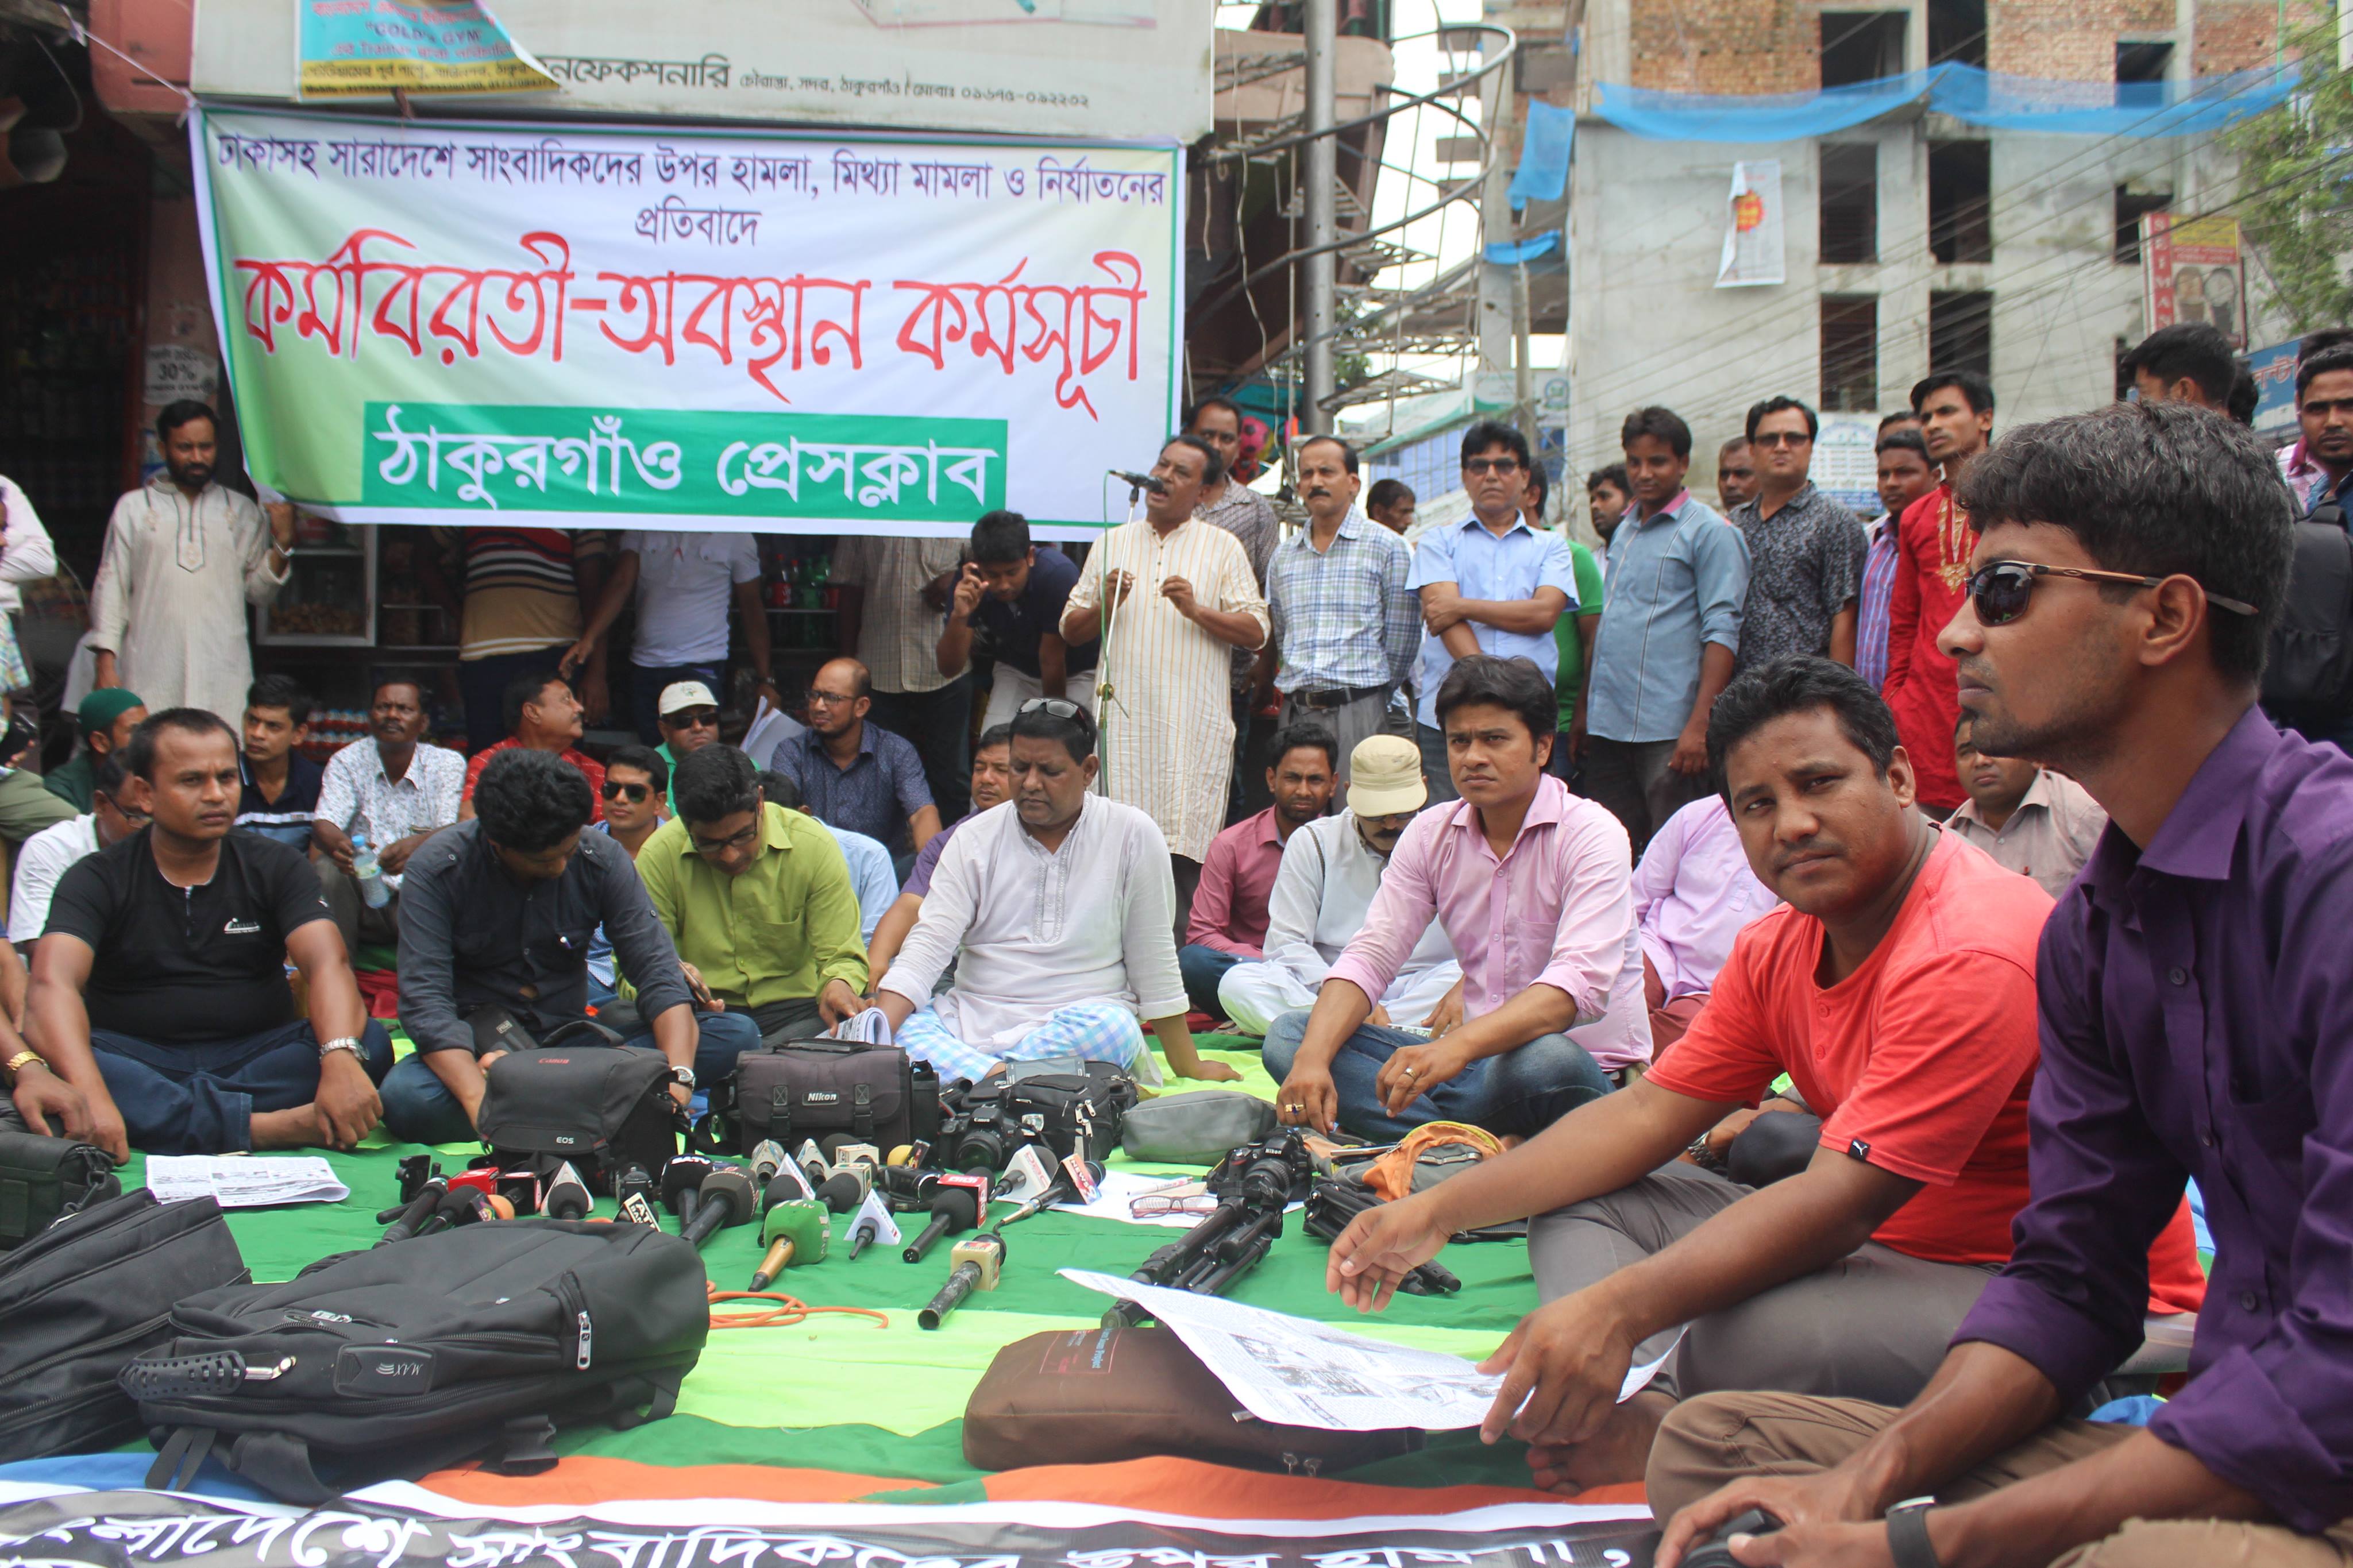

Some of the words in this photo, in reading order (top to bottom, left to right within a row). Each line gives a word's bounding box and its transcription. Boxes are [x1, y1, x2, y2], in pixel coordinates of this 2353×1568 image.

[218, 133, 319, 179] ঢাকাসহ
[329, 137, 457, 180] সারাদেশে
[466, 137, 645, 186] সাংবাদিকদের
[655, 144, 722, 192] উপর
[731, 153, 818, 200] হামলা,
[832, 148, 901, 197] মিথ্যা
[912, 160, 993, 200] মামলা
[1004, 169, 1026, 198] ও
[1037, 155, 1166, 207] নির্যাতনের
[636, 195, 762, 247] প্রতিবাদে
[893, 250, 1147, 422] কর্মসূচী
[372, 404, 683, 510] ঠাকুরগাঁও
[716, 435, 1000, 508] প্রেসক্লাব
[807, 1092, 838, 1102] Nikon
[556, 1136, 574, 1145] EOS
[393, 1362, 423, 1377] MAX
